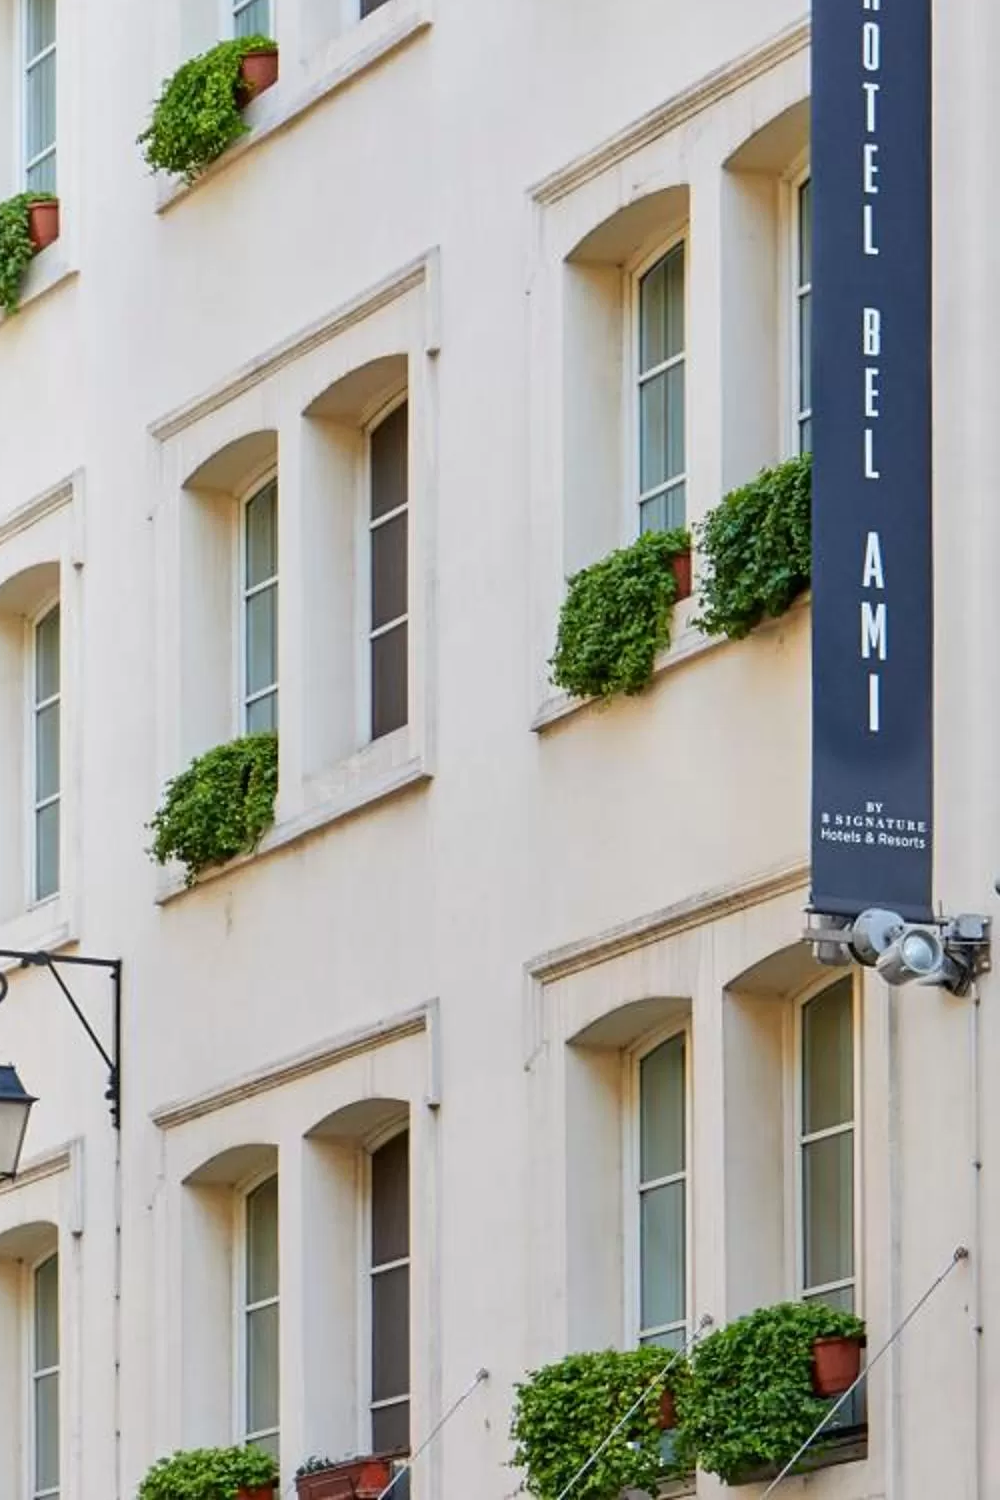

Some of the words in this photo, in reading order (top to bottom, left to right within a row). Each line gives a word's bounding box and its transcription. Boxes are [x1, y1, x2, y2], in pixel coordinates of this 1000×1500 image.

[863, 307, 881, 479] BEL
[861, 531, 887, 732] AMI
[866, 802, 883, 813] BY
[835, 814, 927, 833] SIGNATURE
[821, 828, 861, 843] Hotels
[865, 832, 875, 844] &
[878, 833, 926, 849] Resorts
